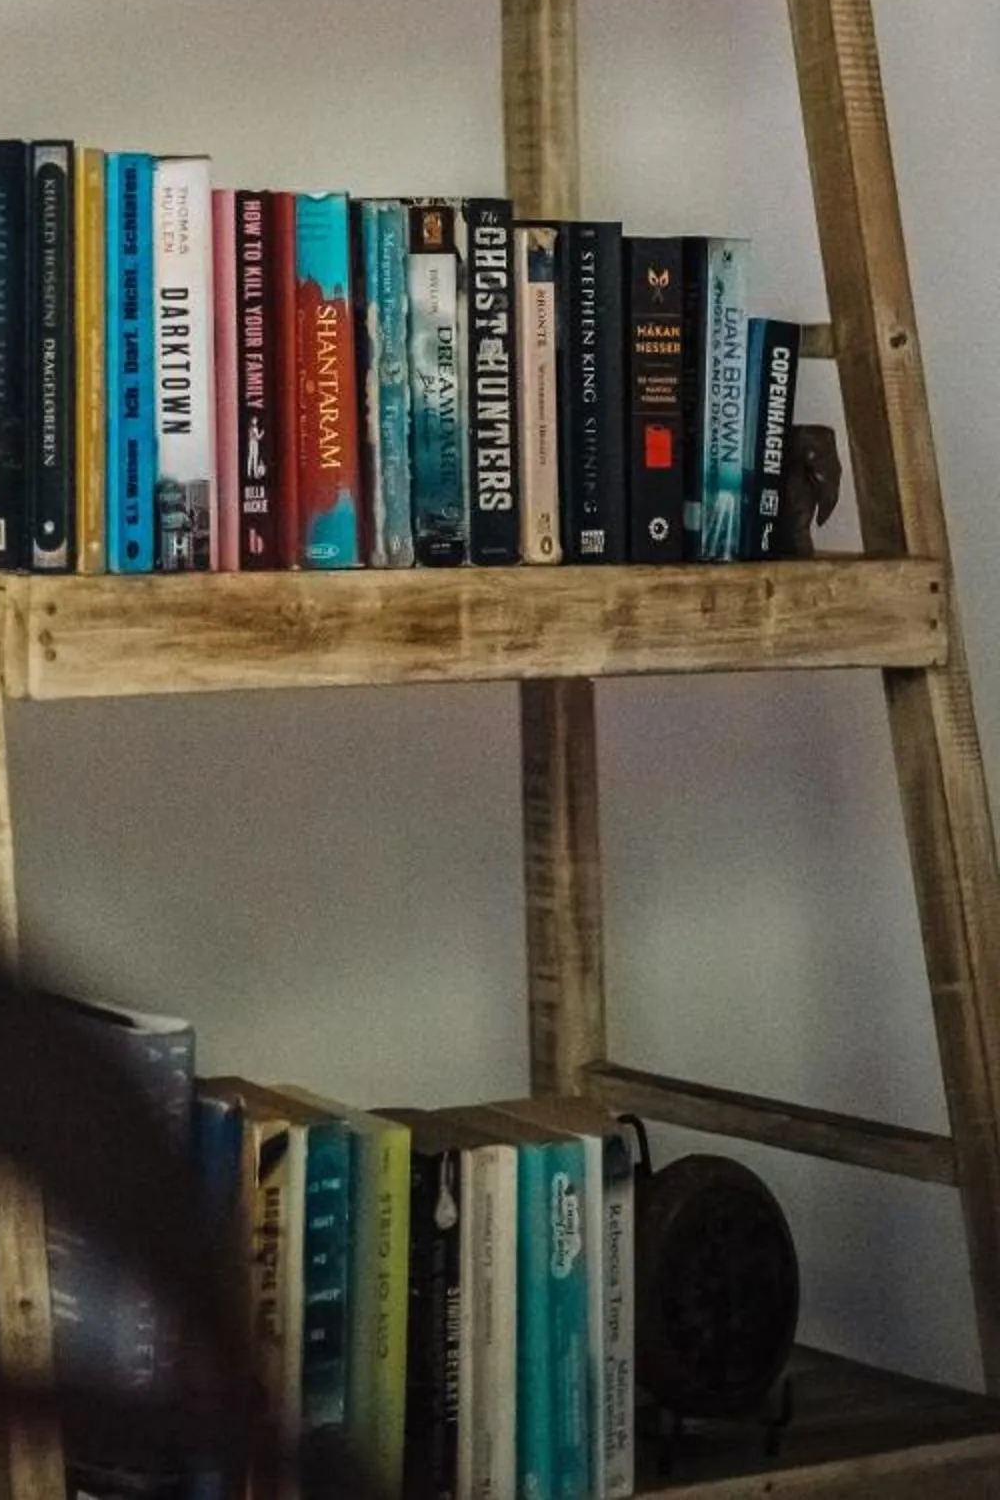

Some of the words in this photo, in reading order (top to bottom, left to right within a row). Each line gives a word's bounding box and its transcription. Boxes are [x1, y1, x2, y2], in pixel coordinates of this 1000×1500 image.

[162, 185, 176, 254] MULLEN
[178, 185, 191, 256] THOMAS
[243, 200, 263, 237] HOW
[244, 240, 263, 262] TO
[475, 226, 508, 335] GHOST
[244, 266, 264, 300] KILL
[580, 250, 597, 345] STEPHEN
[713, 277, 726, 350] ANGELS
[245, 305, 265, 348] YOUR
[635, 341, 682, 354] NESSER
[636, 321, 681, 337] HÅKAN
[723, 307, 744, 359] DAN
[160, 286, 192, 436] DARKTOWN
[245, 353, 266, 409] FAMILY
[315, 304, 343, 469] SHANTARAM
[581, 352, 598, 404] KING
[711, 355, 722, 397] AND
[477, 356, 513, 513] HUNTERS
[720, 365, 742, 464] BROWN
[763, 347, 791, 476] COPENHAGEN
[608, 1203, 623, 1288] Rebecca
[446, 1286, 461, 1342] SIMON
